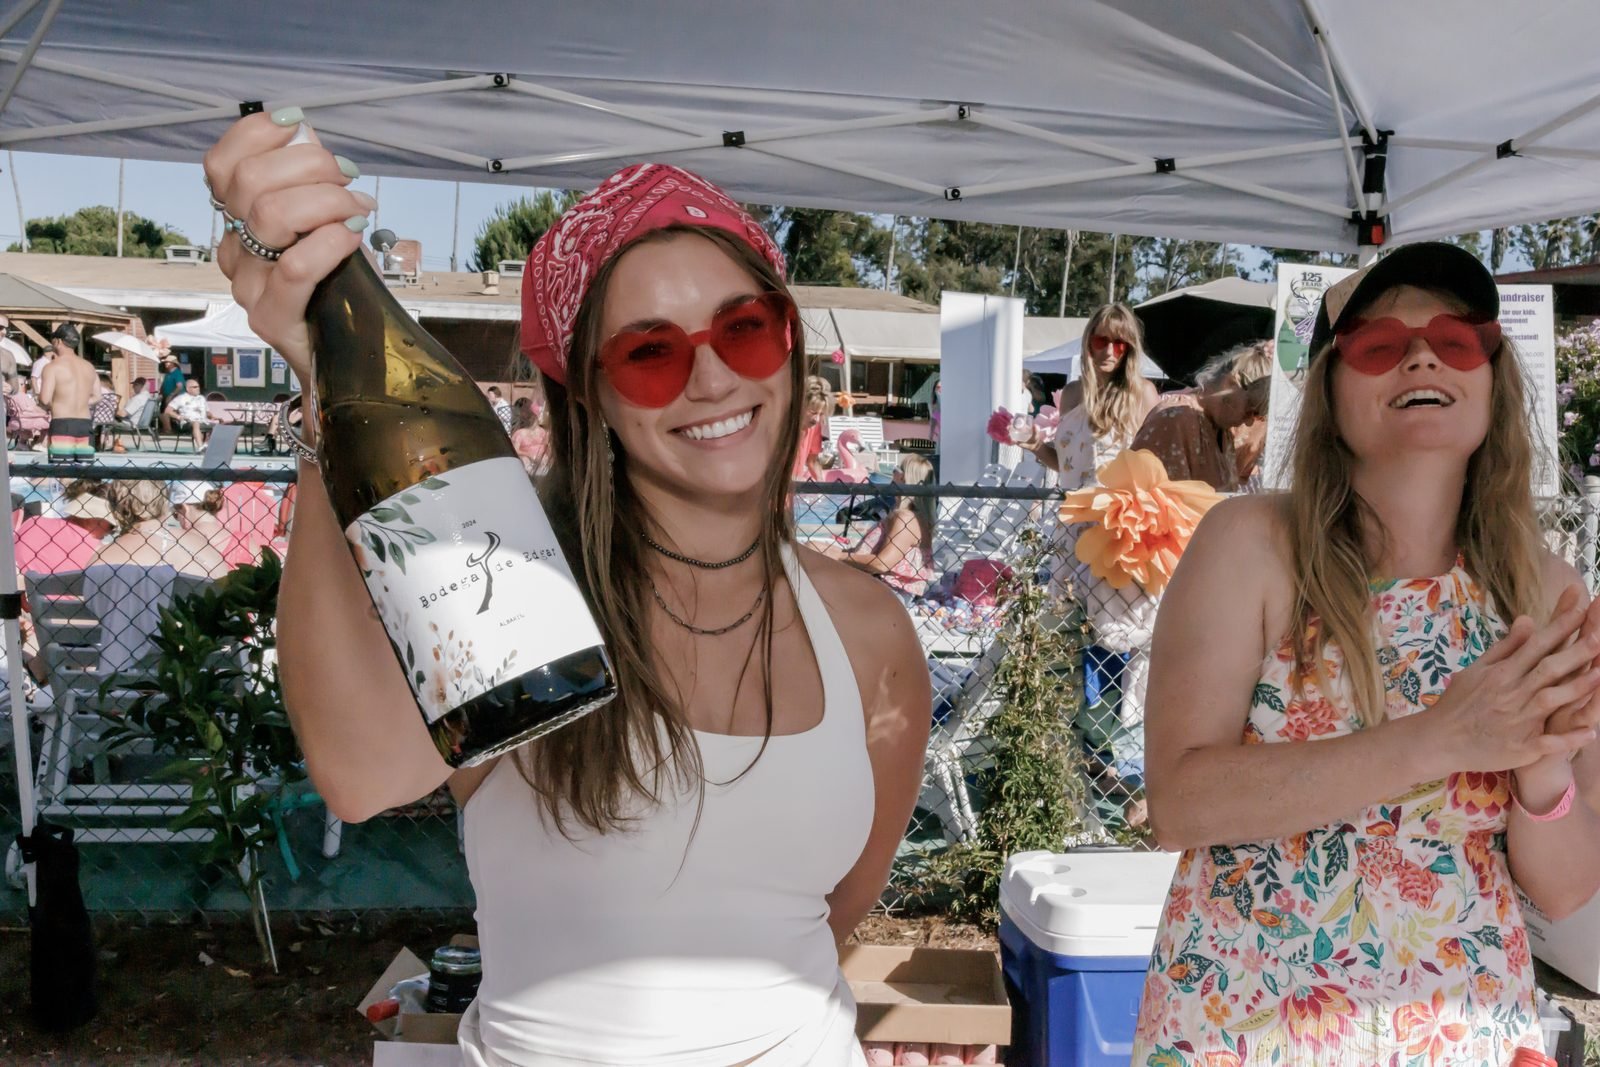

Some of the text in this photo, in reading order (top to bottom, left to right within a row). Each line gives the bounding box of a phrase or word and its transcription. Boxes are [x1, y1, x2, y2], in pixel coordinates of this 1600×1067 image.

[1301, 271, 1322, 282] 125
[1500, 293, 1544, 302] undraiser
[461, 519, 477, 529] 2024
[418, 573, 480, 609] Bodega
[495, 559, 514, 572] de
